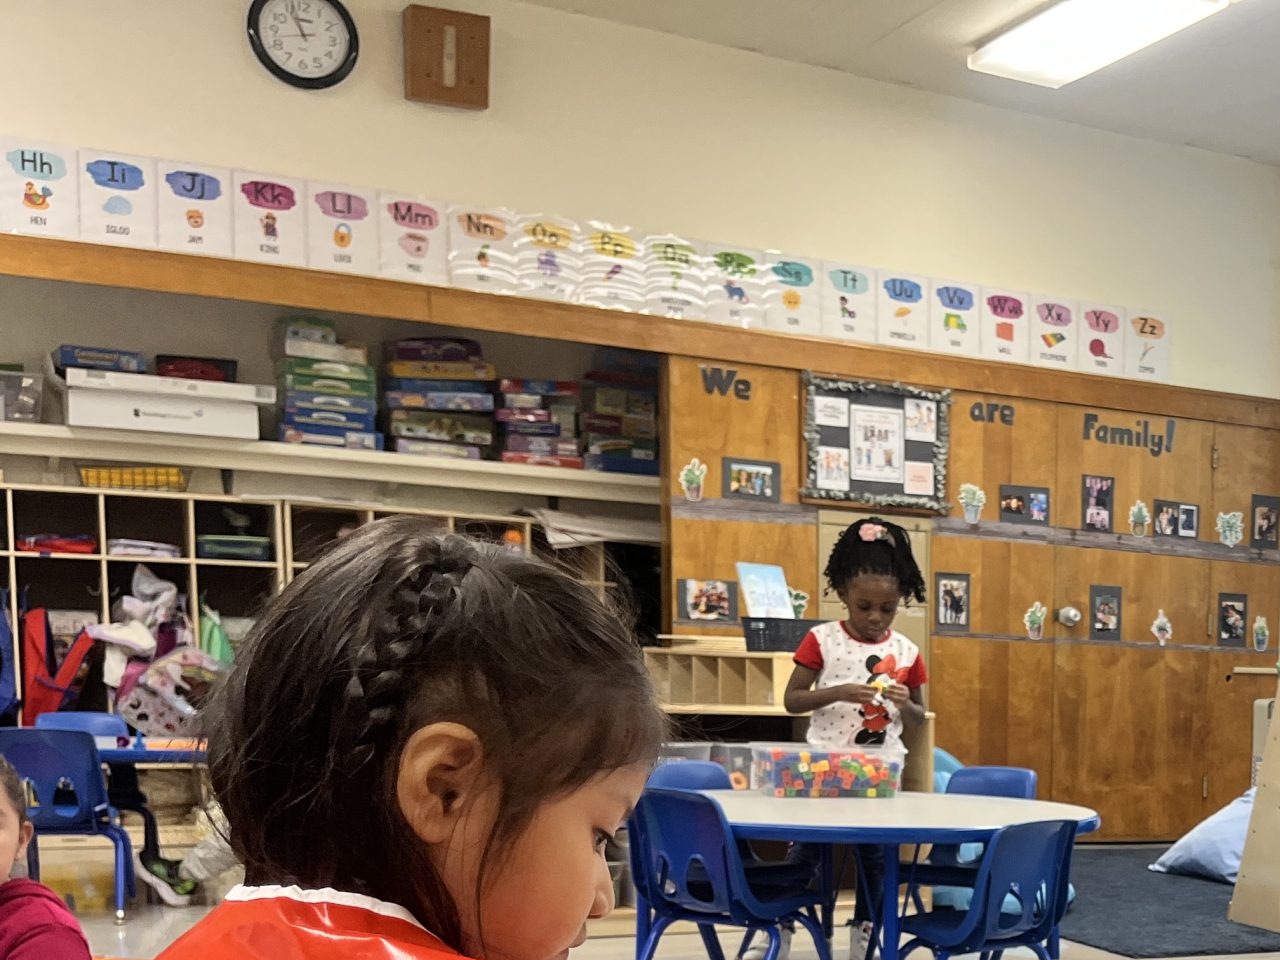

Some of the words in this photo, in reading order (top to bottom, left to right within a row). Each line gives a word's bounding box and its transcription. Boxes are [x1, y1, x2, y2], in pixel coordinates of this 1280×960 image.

[297, 0, 312, 13] 12
[273, 12, 287, 24] 10
[269, 24, 279, 37] 9
[273, 39, 284, 51] 8
[328, 36, 337, 47] 3
[282, 51, 293, 65] 7
[312, 56, 323, 68] 5
[324, 50, 333, 60] 4
[298, 59, 308, 70] 6
[21, 150, 53, 175] Hh
[106, 161, 126, 184] Ii
[182, 172, 205, 199] Jj
[254, 182, 283, 205] Kk
[393, 202, 433, 227] Mm
[466, 213, 495, 236] Nn
[531, 223, 559, 245] Oo
[840, 270, 858, 289] Tt
[892, 279, 914, 298] Uu
[943, 287, 965, 305] Vv
[991, 297, 1019, 315] Ww
[1045, 303, 1063, 322] Xx
[1092, 310, 1111, 333] Yy
[1138, 317, 1157, 335] Zz
[701, 367, 752, 400] We
[970, 401, 1015, 425] are
[1083, 413, 1176, 457] Family!
